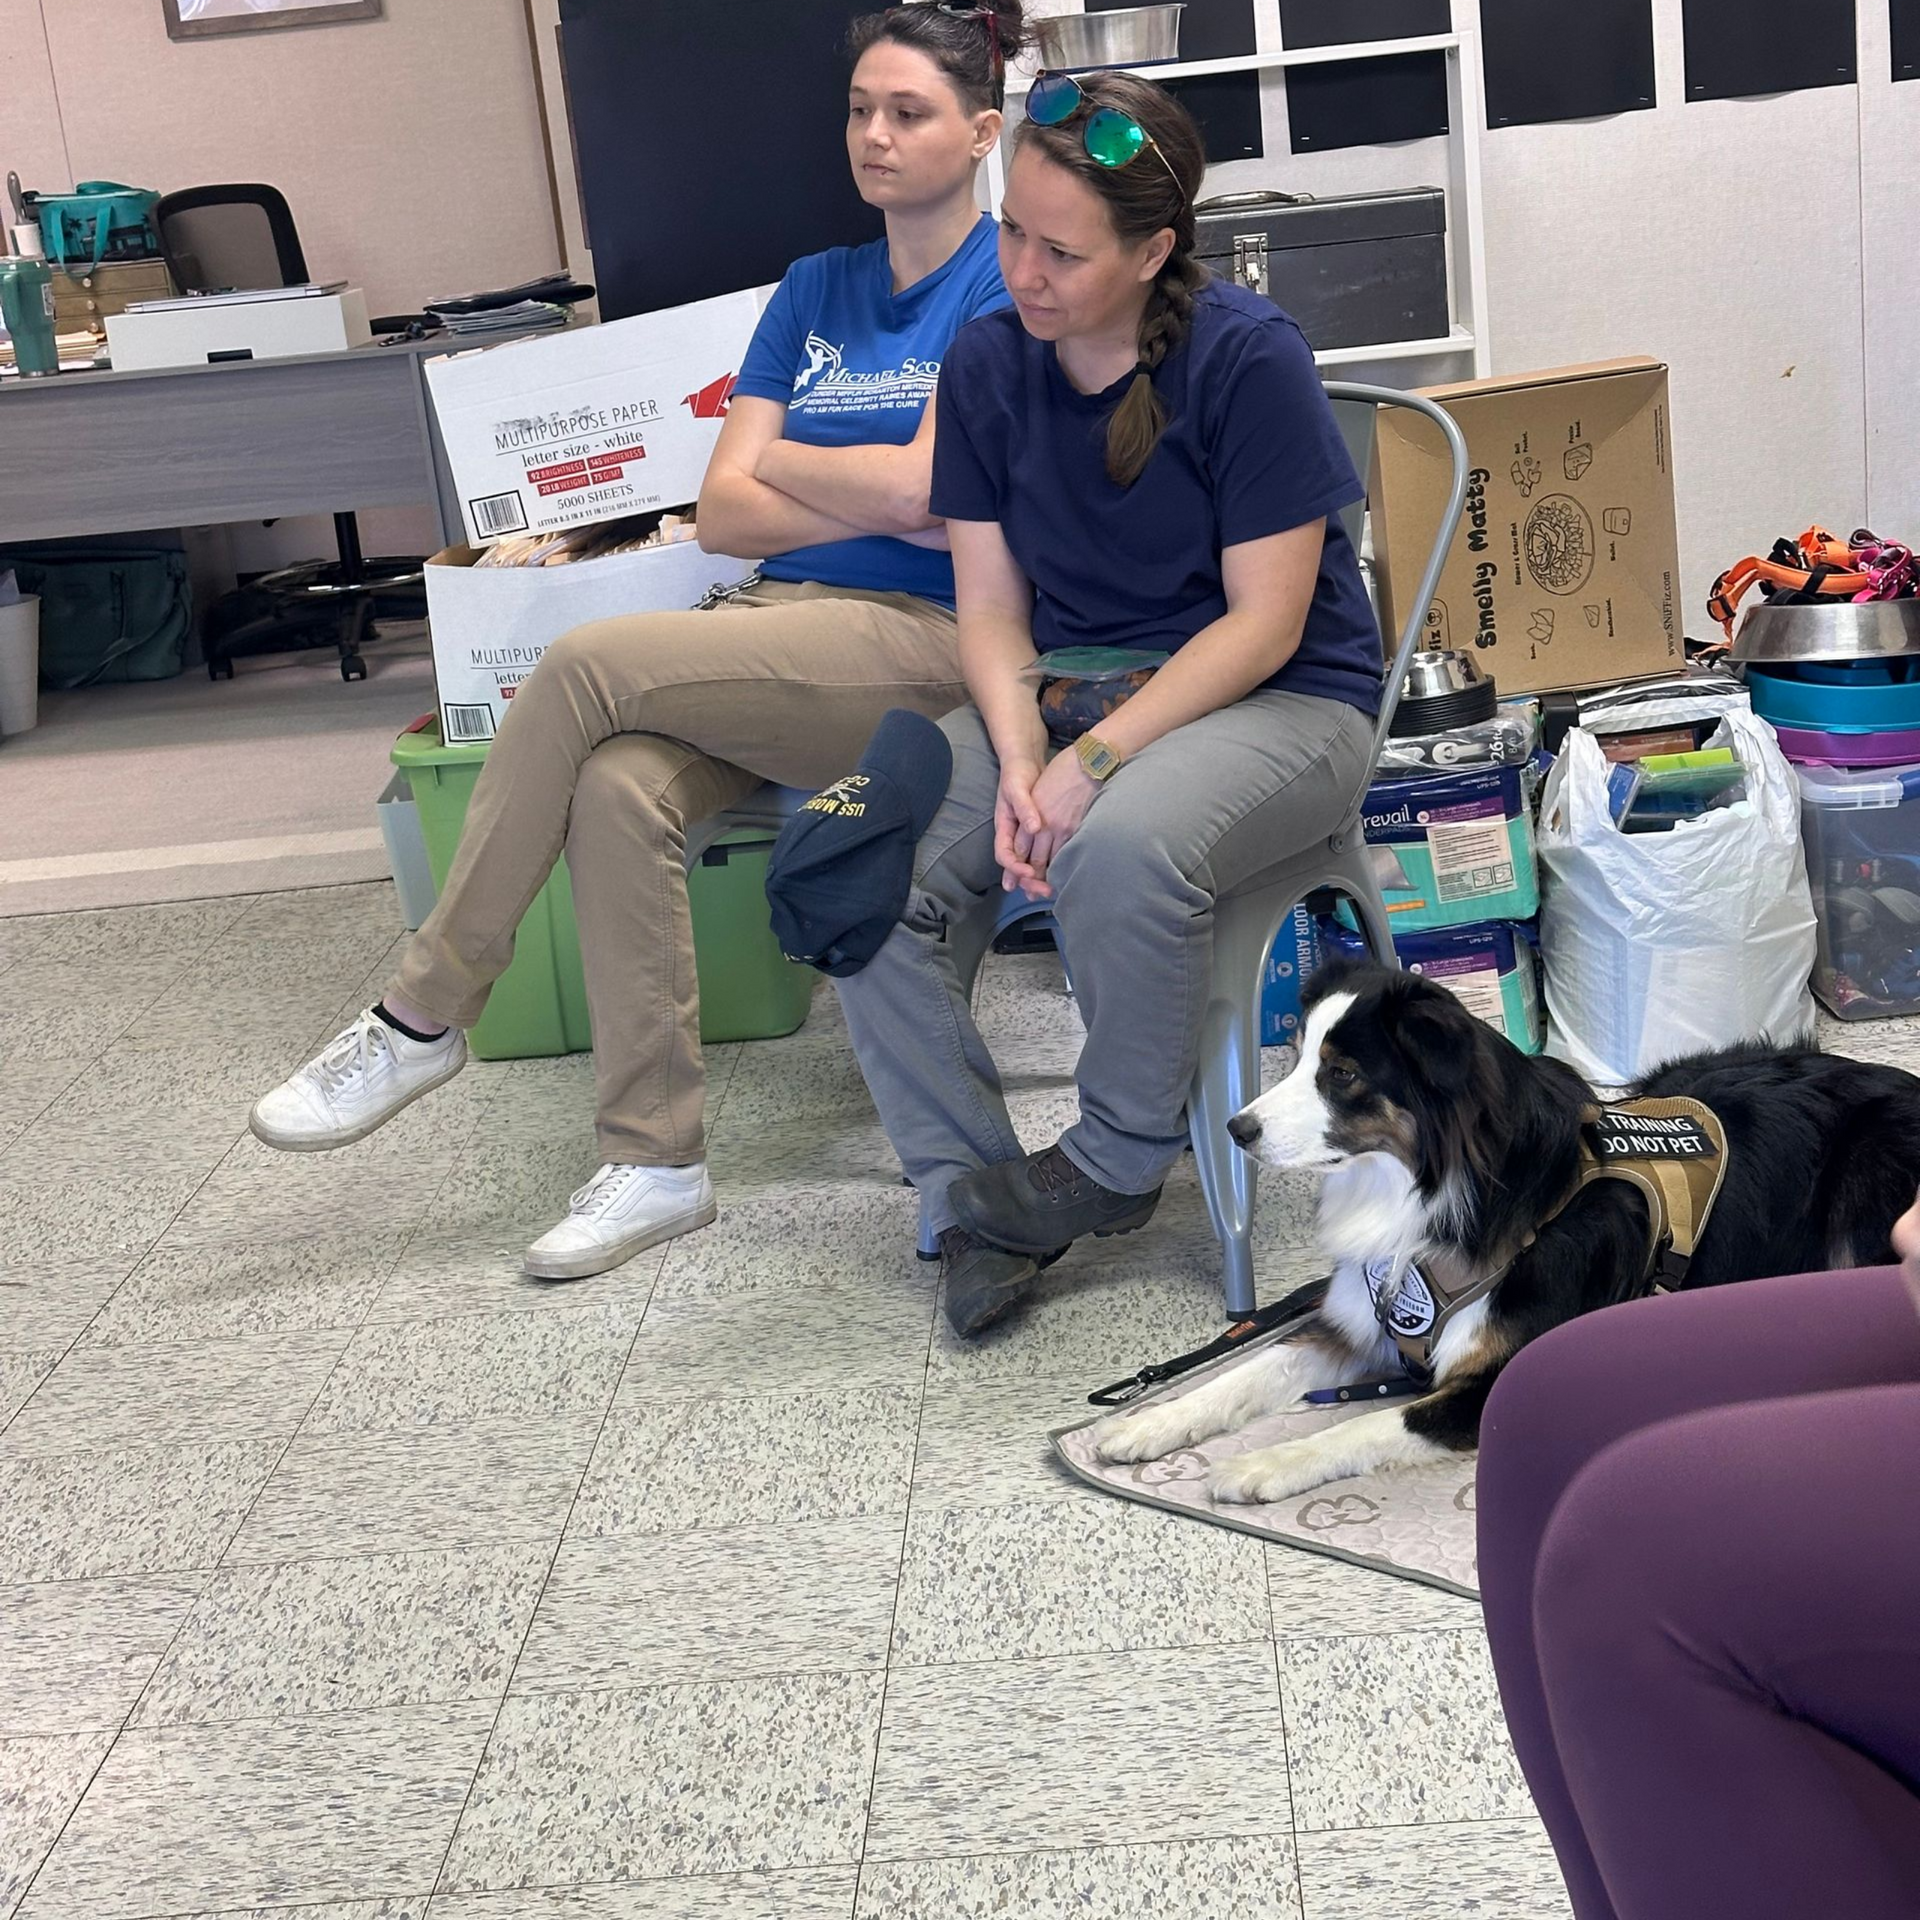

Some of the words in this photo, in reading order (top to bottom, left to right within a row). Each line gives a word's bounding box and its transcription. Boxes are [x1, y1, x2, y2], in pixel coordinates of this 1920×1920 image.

[863, 402, 879, 411] FOR
[895, 400, 920, 408] CURE
[495, 410, 609, 450] MULTIPURPOSE
[612, 399, 659, 424] PAPER
[522, 450, 558, 467] letter
[563, 443, 590, 456] size
[603, 431, 643, 448] white
[603, 449, 642, 464] WHITENESS
[531, 472, 541, 481] 92
[541, 462, 584, 479] BRIGHTNESS
[541, 484, 550, 493] 20
[551, 481, 560, 491] LB
[560, 477, 588, 489] WEIGHT
[558, 494, 585, 510] 5000
[587, 484, 634, 503] SHEETS
[1466, 467, 1492, 552] Matty
[1473, 561, 1498, 650] Smelly
[838, 802, 866, 817] USS
[1606, 1114, 1693, 1133] TRAINING
[1629, 1135, 1670, 1153] NOT
[1669, 1135, 1703, 1153] PET
